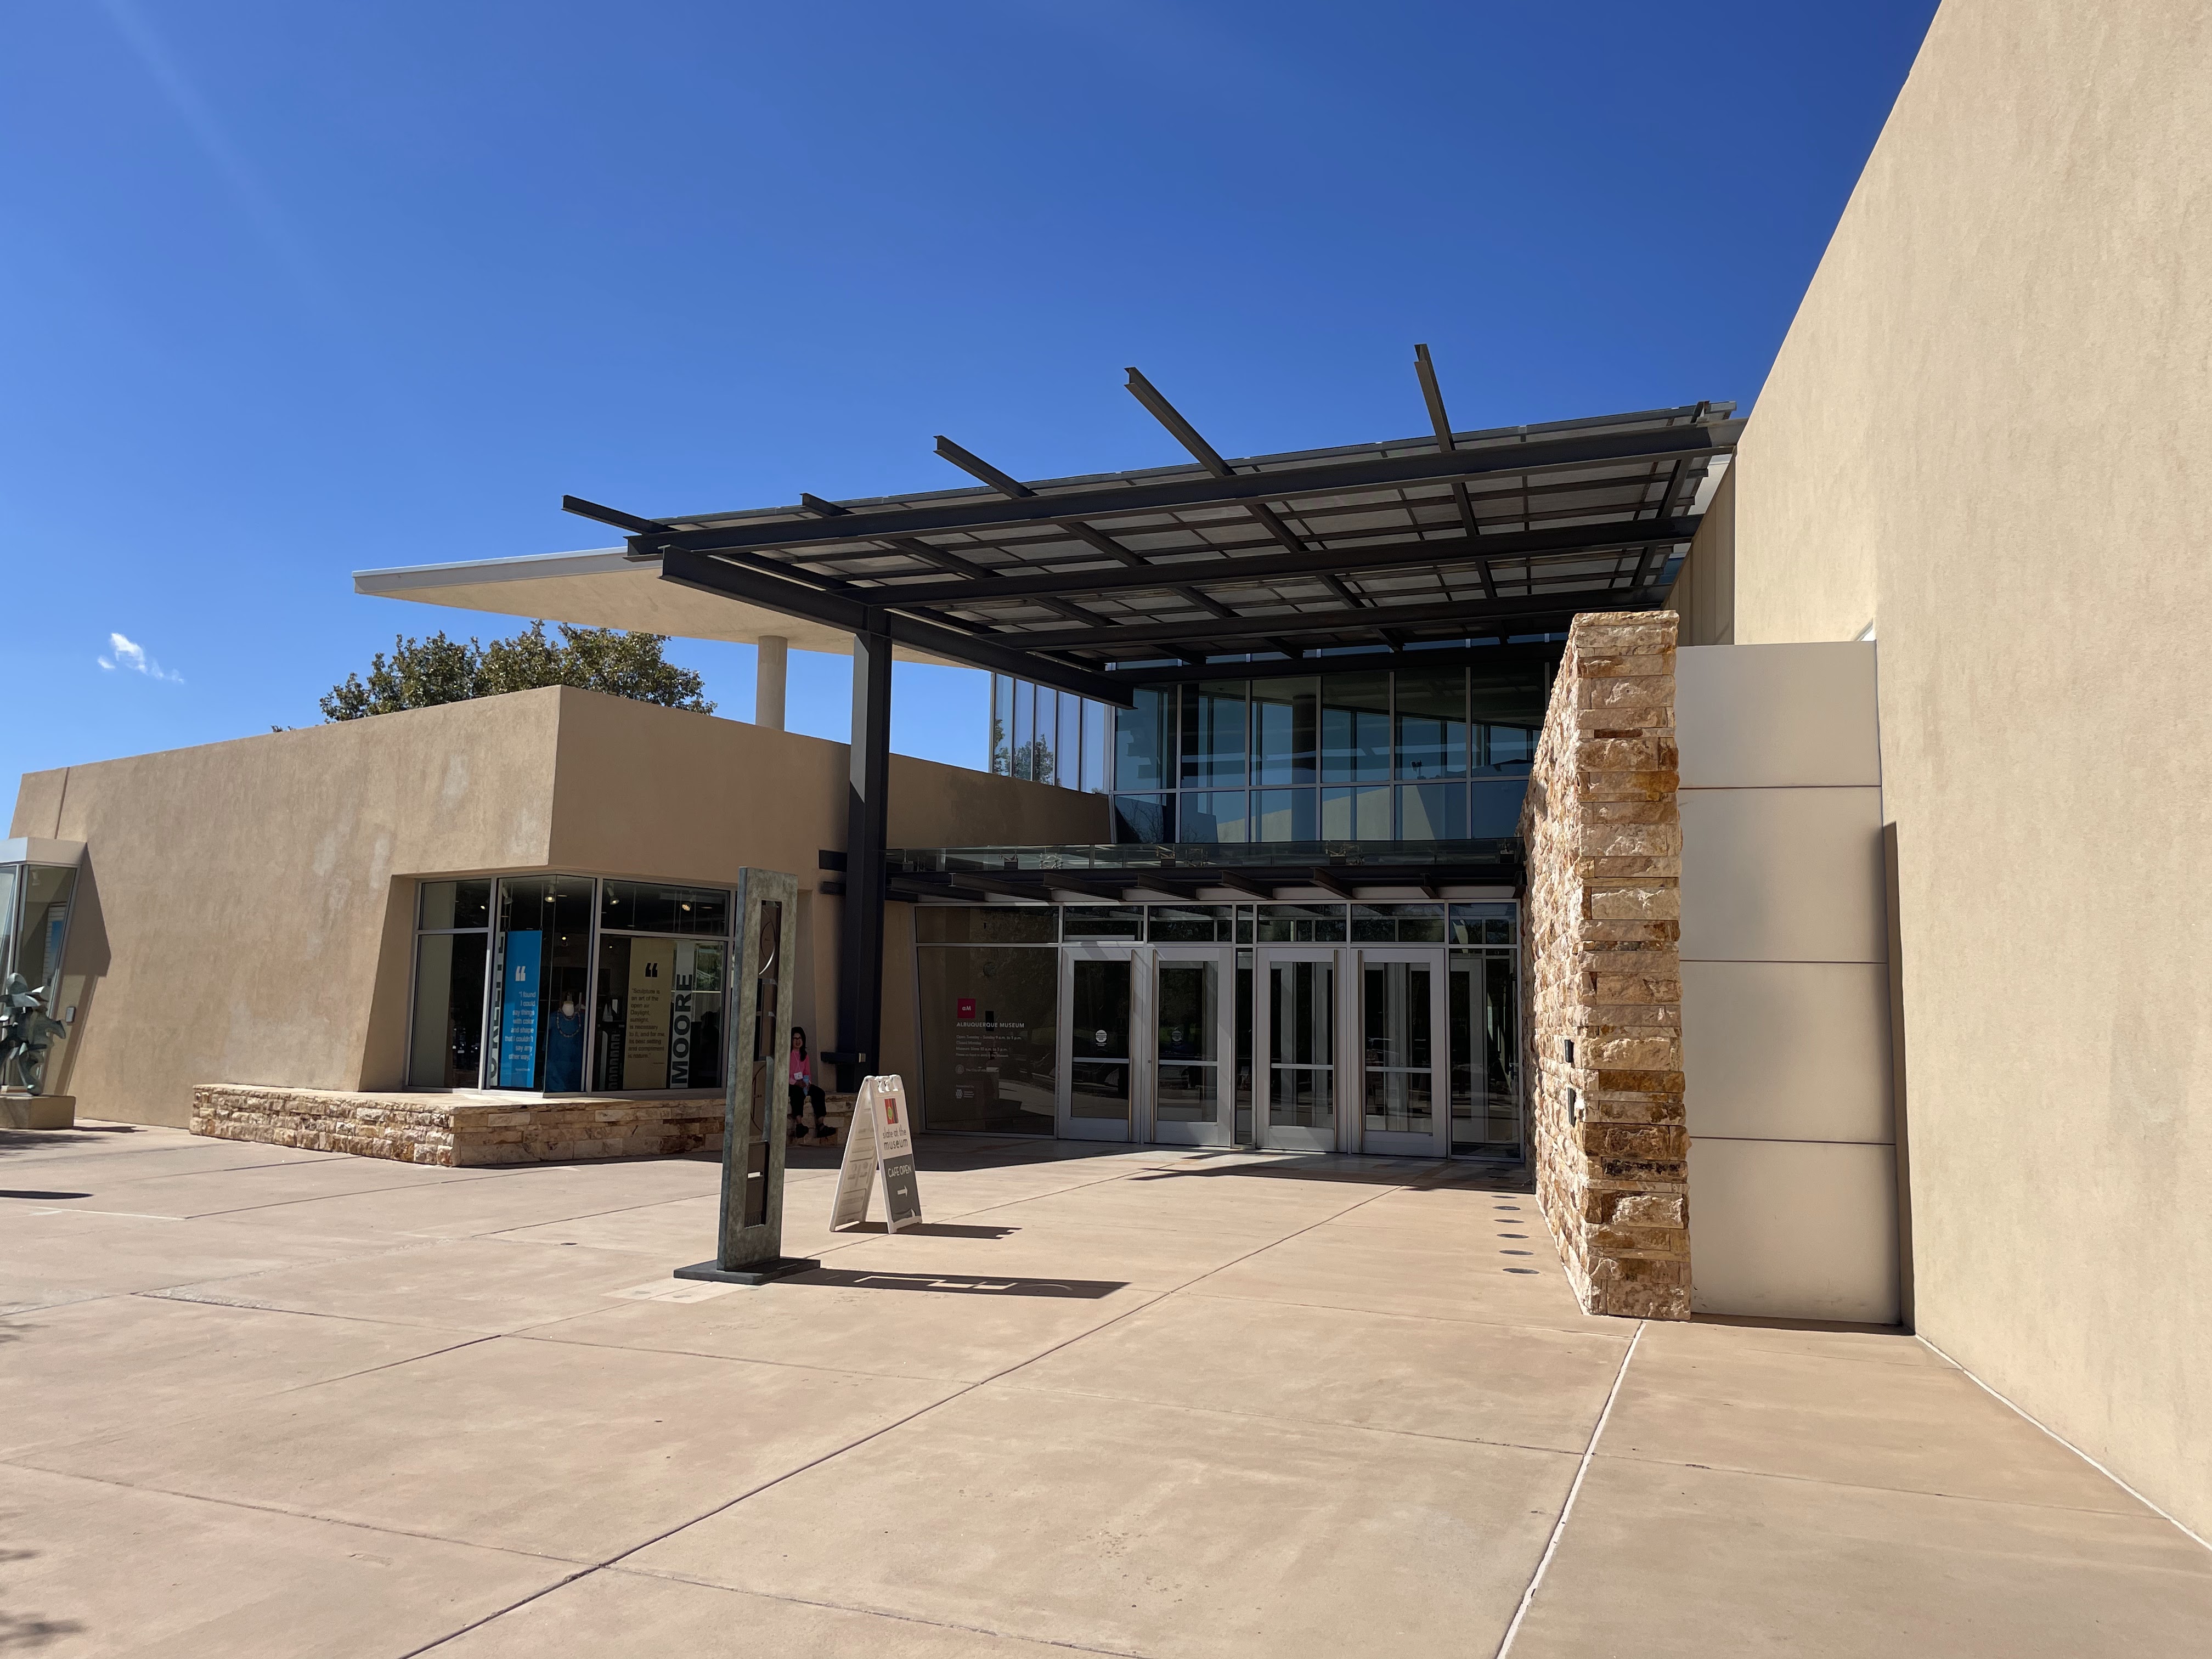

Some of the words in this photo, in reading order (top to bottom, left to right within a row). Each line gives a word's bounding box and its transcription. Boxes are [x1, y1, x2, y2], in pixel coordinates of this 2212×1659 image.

[521, 1009, 535, 1017] things
[672, 974, 693, 1084] MOORE
[883, 1126, 893, 1138] slate
[894, 1127, 899, 1137] at
[884, 1138, 909, 1150] museum
[888, 1166, 900, 1177] CAFE
[899, 1164, 912, 1175] OPEN
